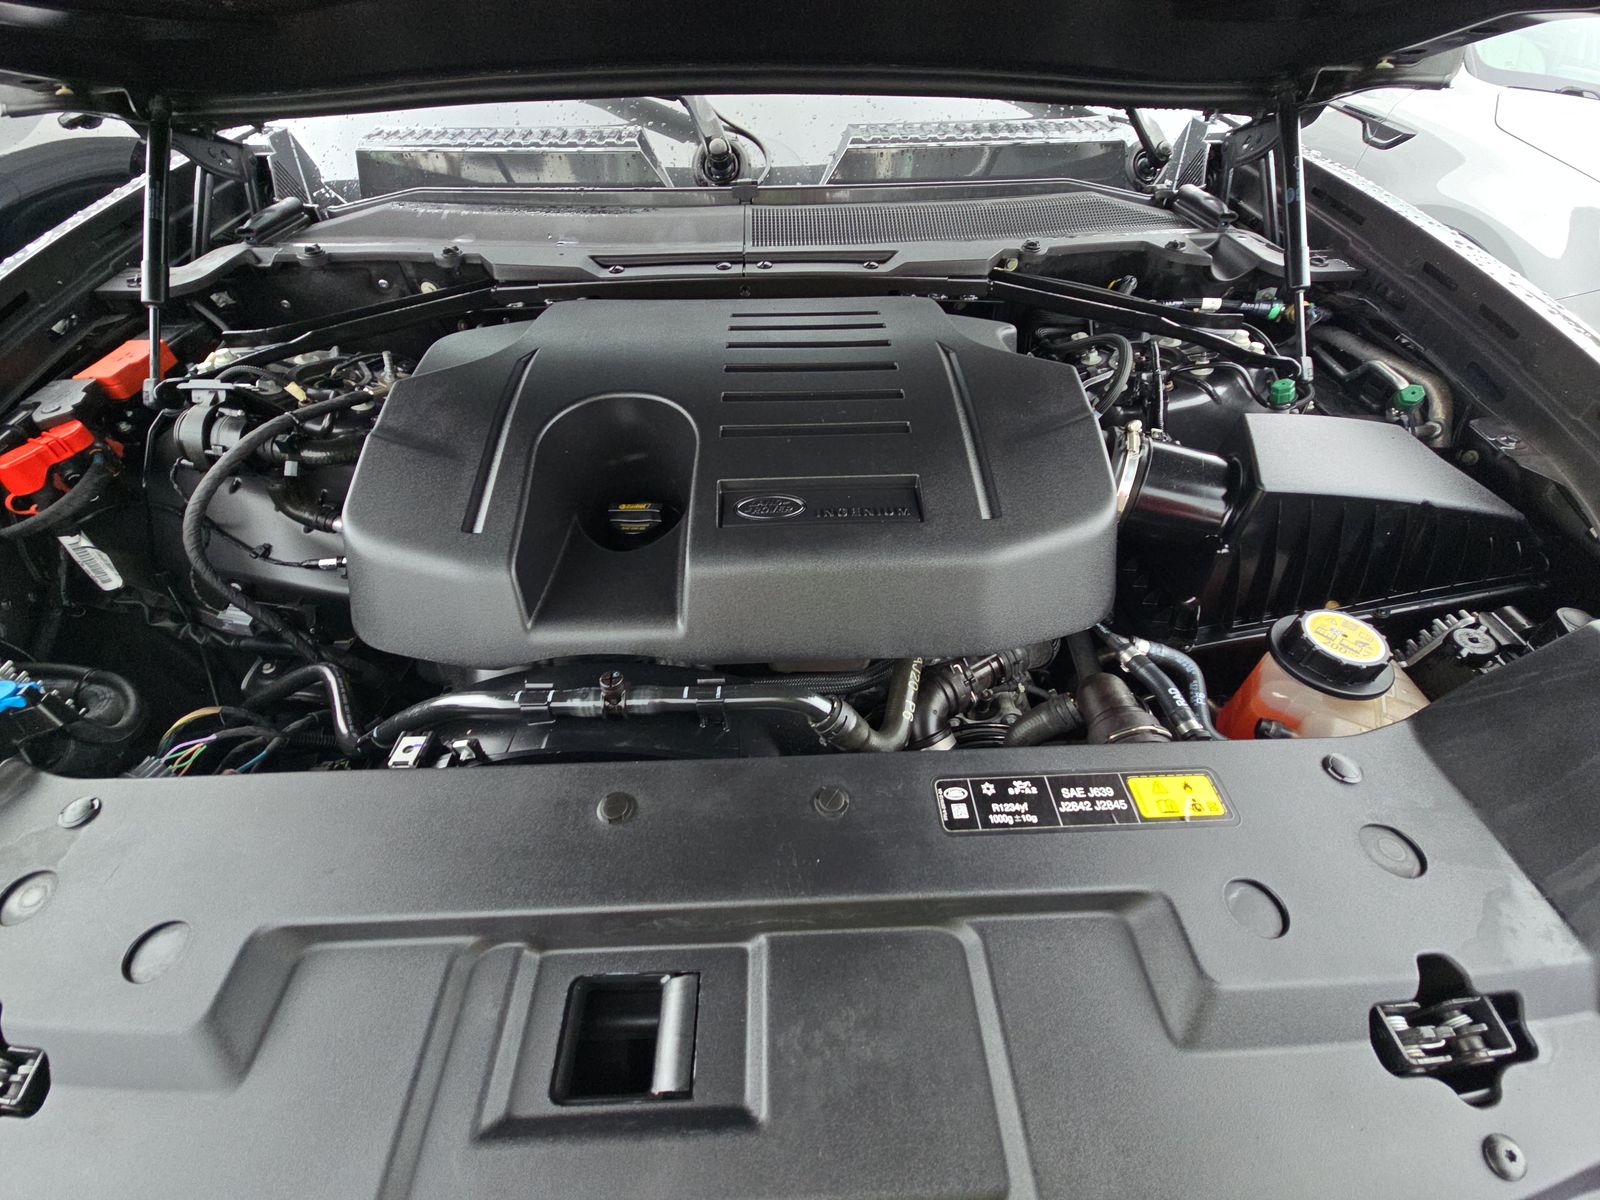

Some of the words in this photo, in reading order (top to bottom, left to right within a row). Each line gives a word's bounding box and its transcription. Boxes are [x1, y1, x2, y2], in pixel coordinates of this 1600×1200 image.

[1168, 688, 1188, 707] RAD
[902, 700, 916, 722] P6
[1061, 787, 1085, 798] SAE
[1087, 786, 1114, 797] J639
[991, 802, 1029, 813] R1234yf
[1059, 800, 1092, 812] J2842
[1094, 799, 1127, 811] J2845
[988, 814, 1014, 825] 1000g
